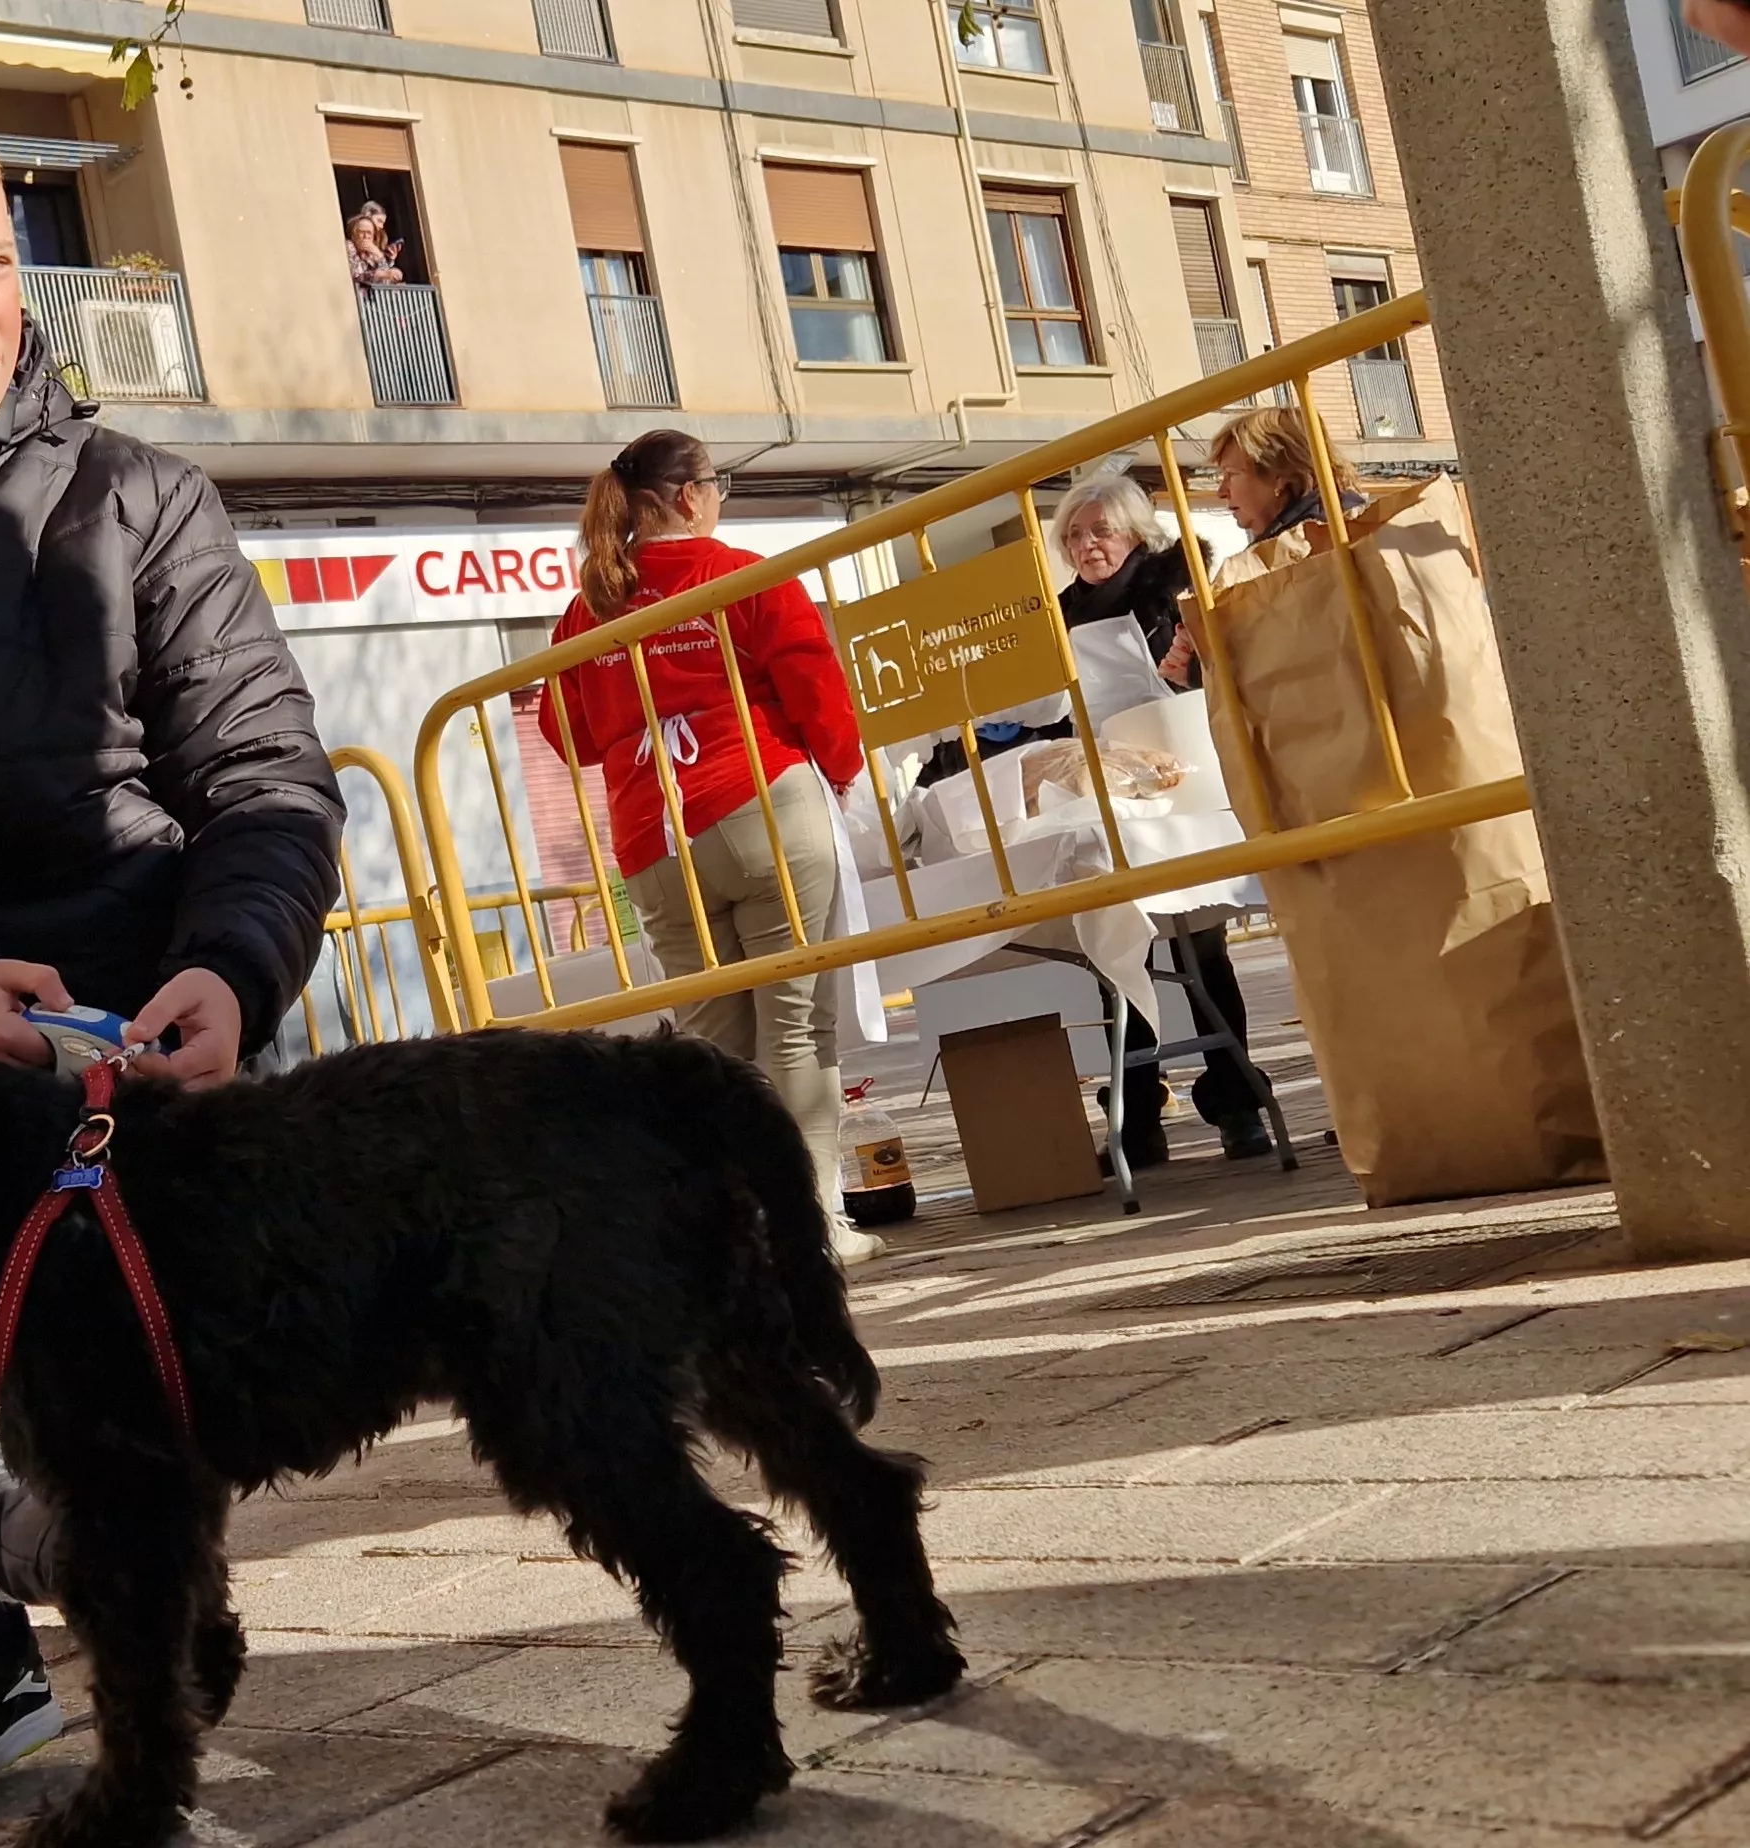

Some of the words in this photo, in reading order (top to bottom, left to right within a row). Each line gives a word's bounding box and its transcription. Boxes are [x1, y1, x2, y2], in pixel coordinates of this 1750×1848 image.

[919, 596, 1041, 650] Ayuntamiento
[648, 636, 716, 656] Montserrat
[924, 655, 947, 676] de
[950, 632, 1019, 668] Huesca
